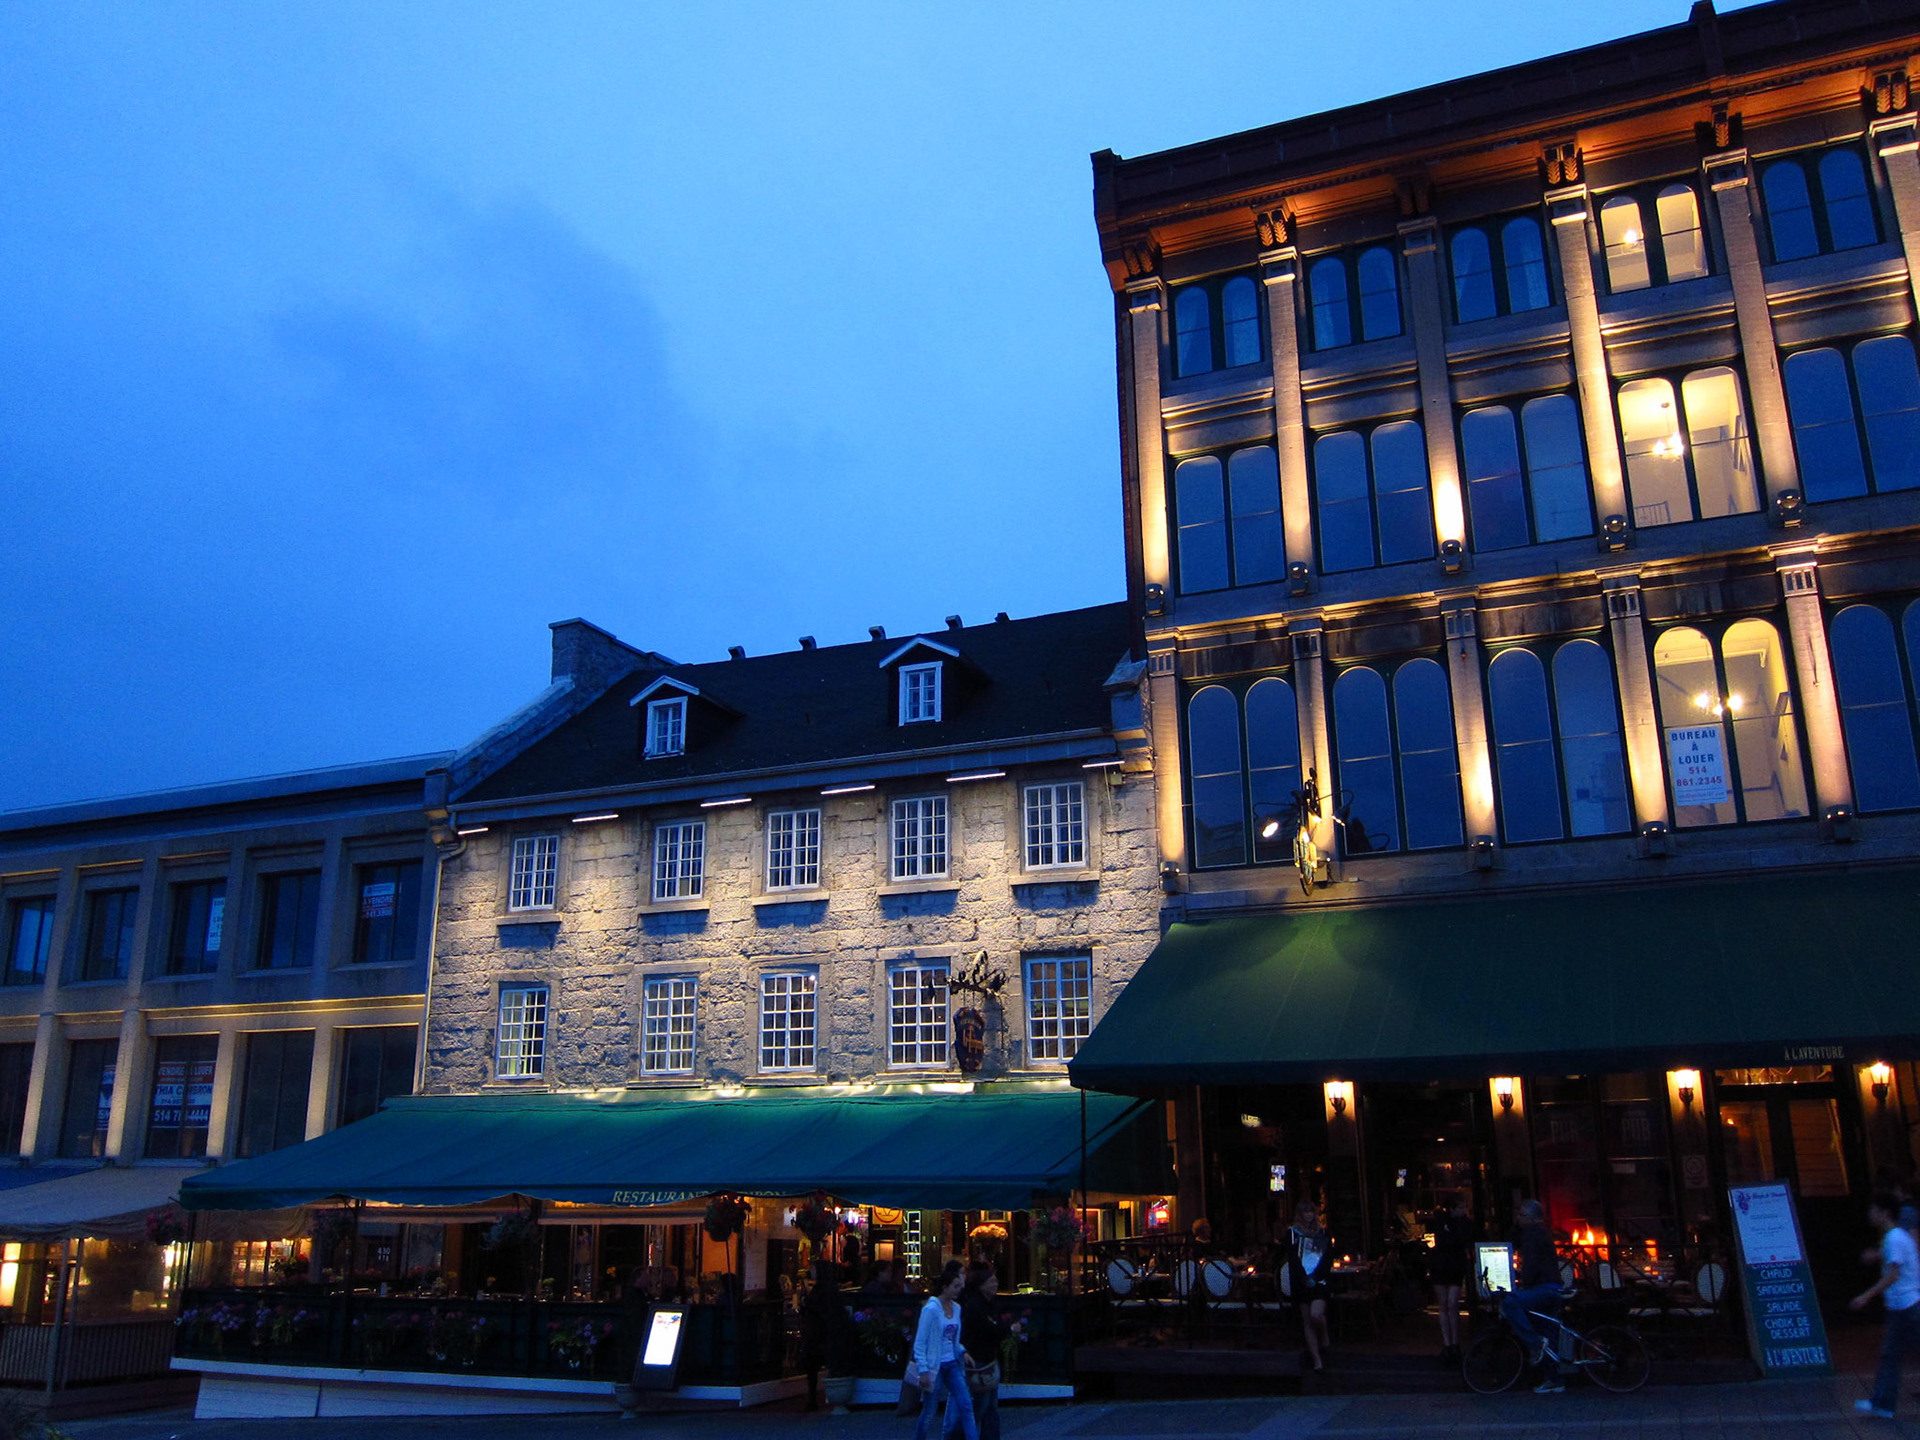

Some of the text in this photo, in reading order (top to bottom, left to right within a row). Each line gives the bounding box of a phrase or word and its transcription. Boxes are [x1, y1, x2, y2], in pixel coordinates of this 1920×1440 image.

[1671, 730, 1716, 741] BUREAU
[1678, 754, 1715, 764] LOUER
[1688, 766, 1707, 774] 514
[1760, 1268, 1793, 1280] CHAUD
[1756, 1283, 1804, 1296] SANDWICH
[1766, 1301, 1802, 1313] SALADE
[1797, 1316, 1810, 1327] DE
[1770, 1327, 1811, 1339] DESSERT
